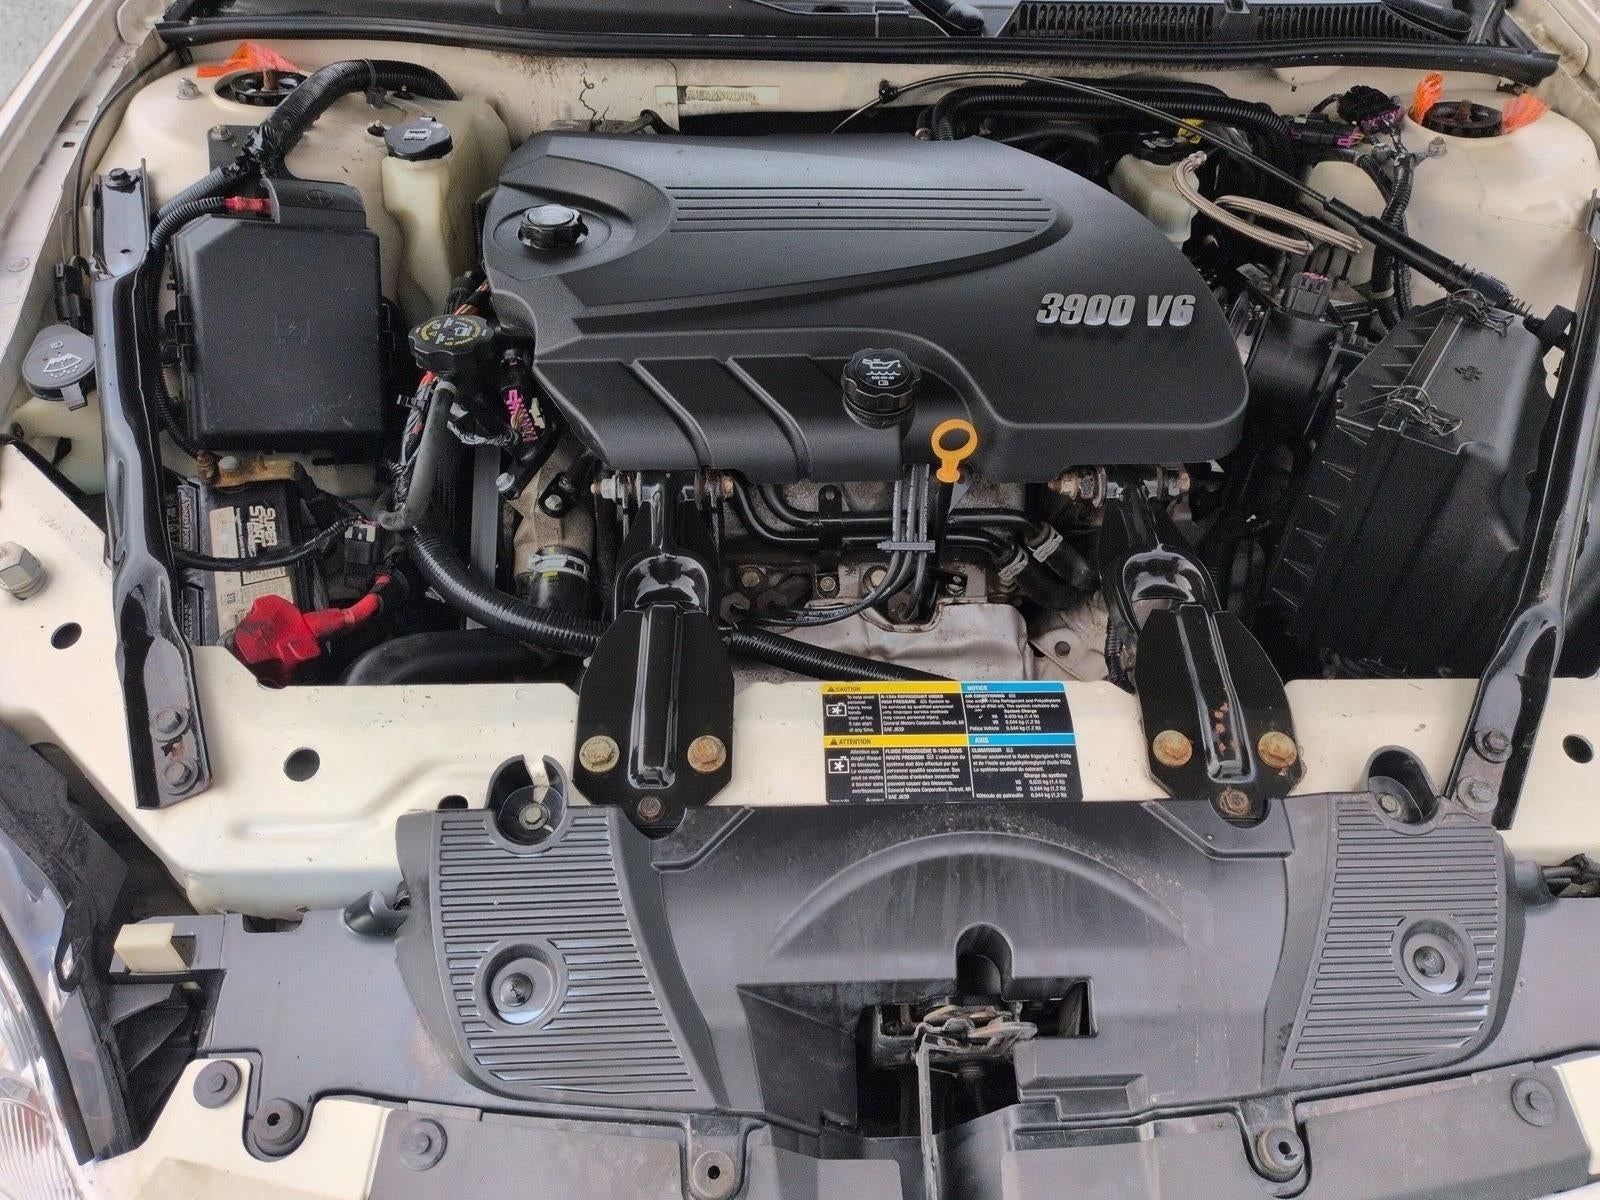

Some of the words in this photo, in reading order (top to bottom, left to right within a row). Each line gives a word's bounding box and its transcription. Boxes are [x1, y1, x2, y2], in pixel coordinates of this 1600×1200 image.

[1036, 292, 1135, 326] 3900
[1147, 294, 1196, 326] V6
[249, 506, 266, 548] START
[266, 507, 277, 546] SUPER
